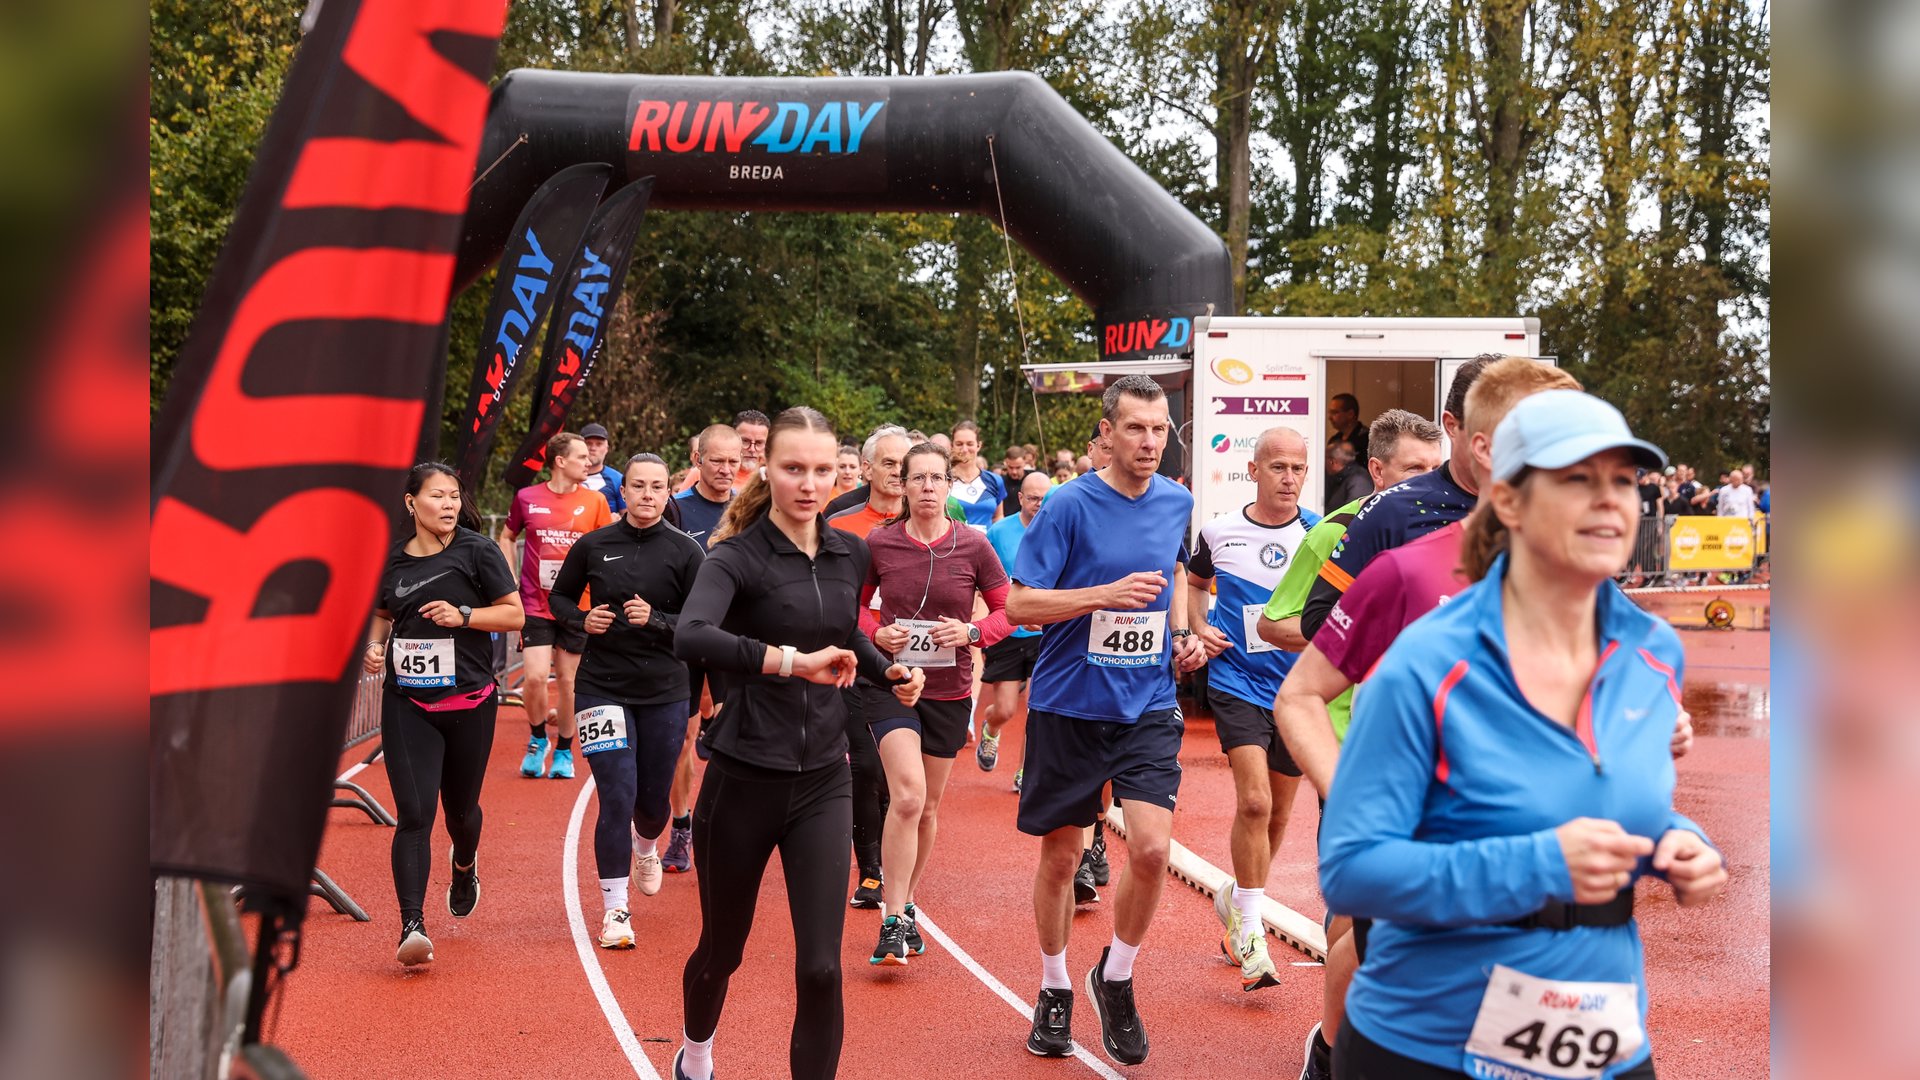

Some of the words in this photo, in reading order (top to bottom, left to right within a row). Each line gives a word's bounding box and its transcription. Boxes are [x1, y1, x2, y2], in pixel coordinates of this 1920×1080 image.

[628, 101, 884, 153] RUN2DAY
[729, 165, 784, 180] BREDA
[1105, 317, 1193, 356] RUN2D
[1243, 398, 1292, 413] LYNX
[548, 530, 571, 538] PART
[1103, 630, 1154, 652] 488
[401, 655, 440, 674] 451
[1093, 655, 1149, 666] TYPHOONLOOP
[579, 719, 615, 744] 554
[1503, 1019, 1619, 1069] 469
